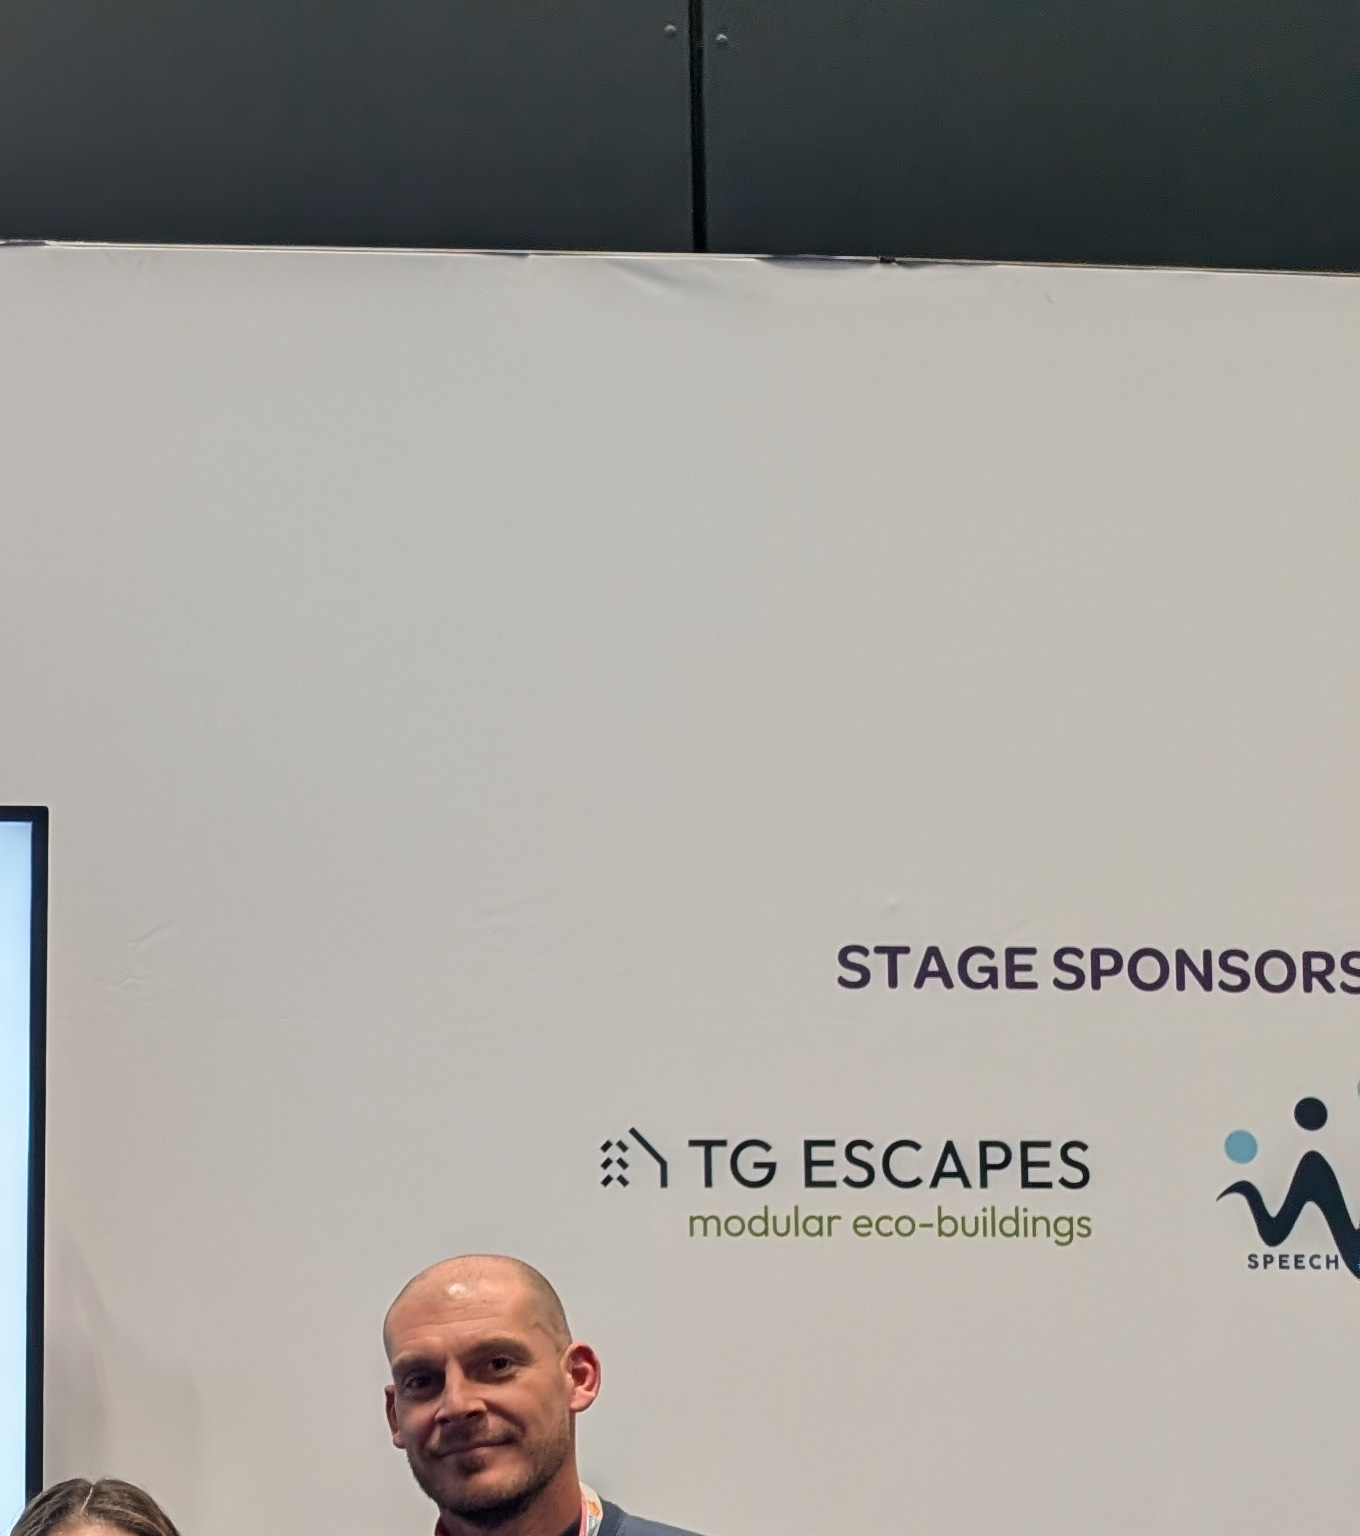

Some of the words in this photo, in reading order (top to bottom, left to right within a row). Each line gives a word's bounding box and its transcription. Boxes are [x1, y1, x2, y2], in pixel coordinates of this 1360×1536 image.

[837, 945, 1038, 990] STAGE
[1053, 947, 1360, 994] SPONSORS
[688, 1139, 777, 1189] TG
[804, 1139, 1090, 1190] ESCAPES
[689, 1205, 841, 1237] modular
[853, 1206, 1091, 1246] eco-buildings
[1247, 1253, 1340, 1270] SPEECH
